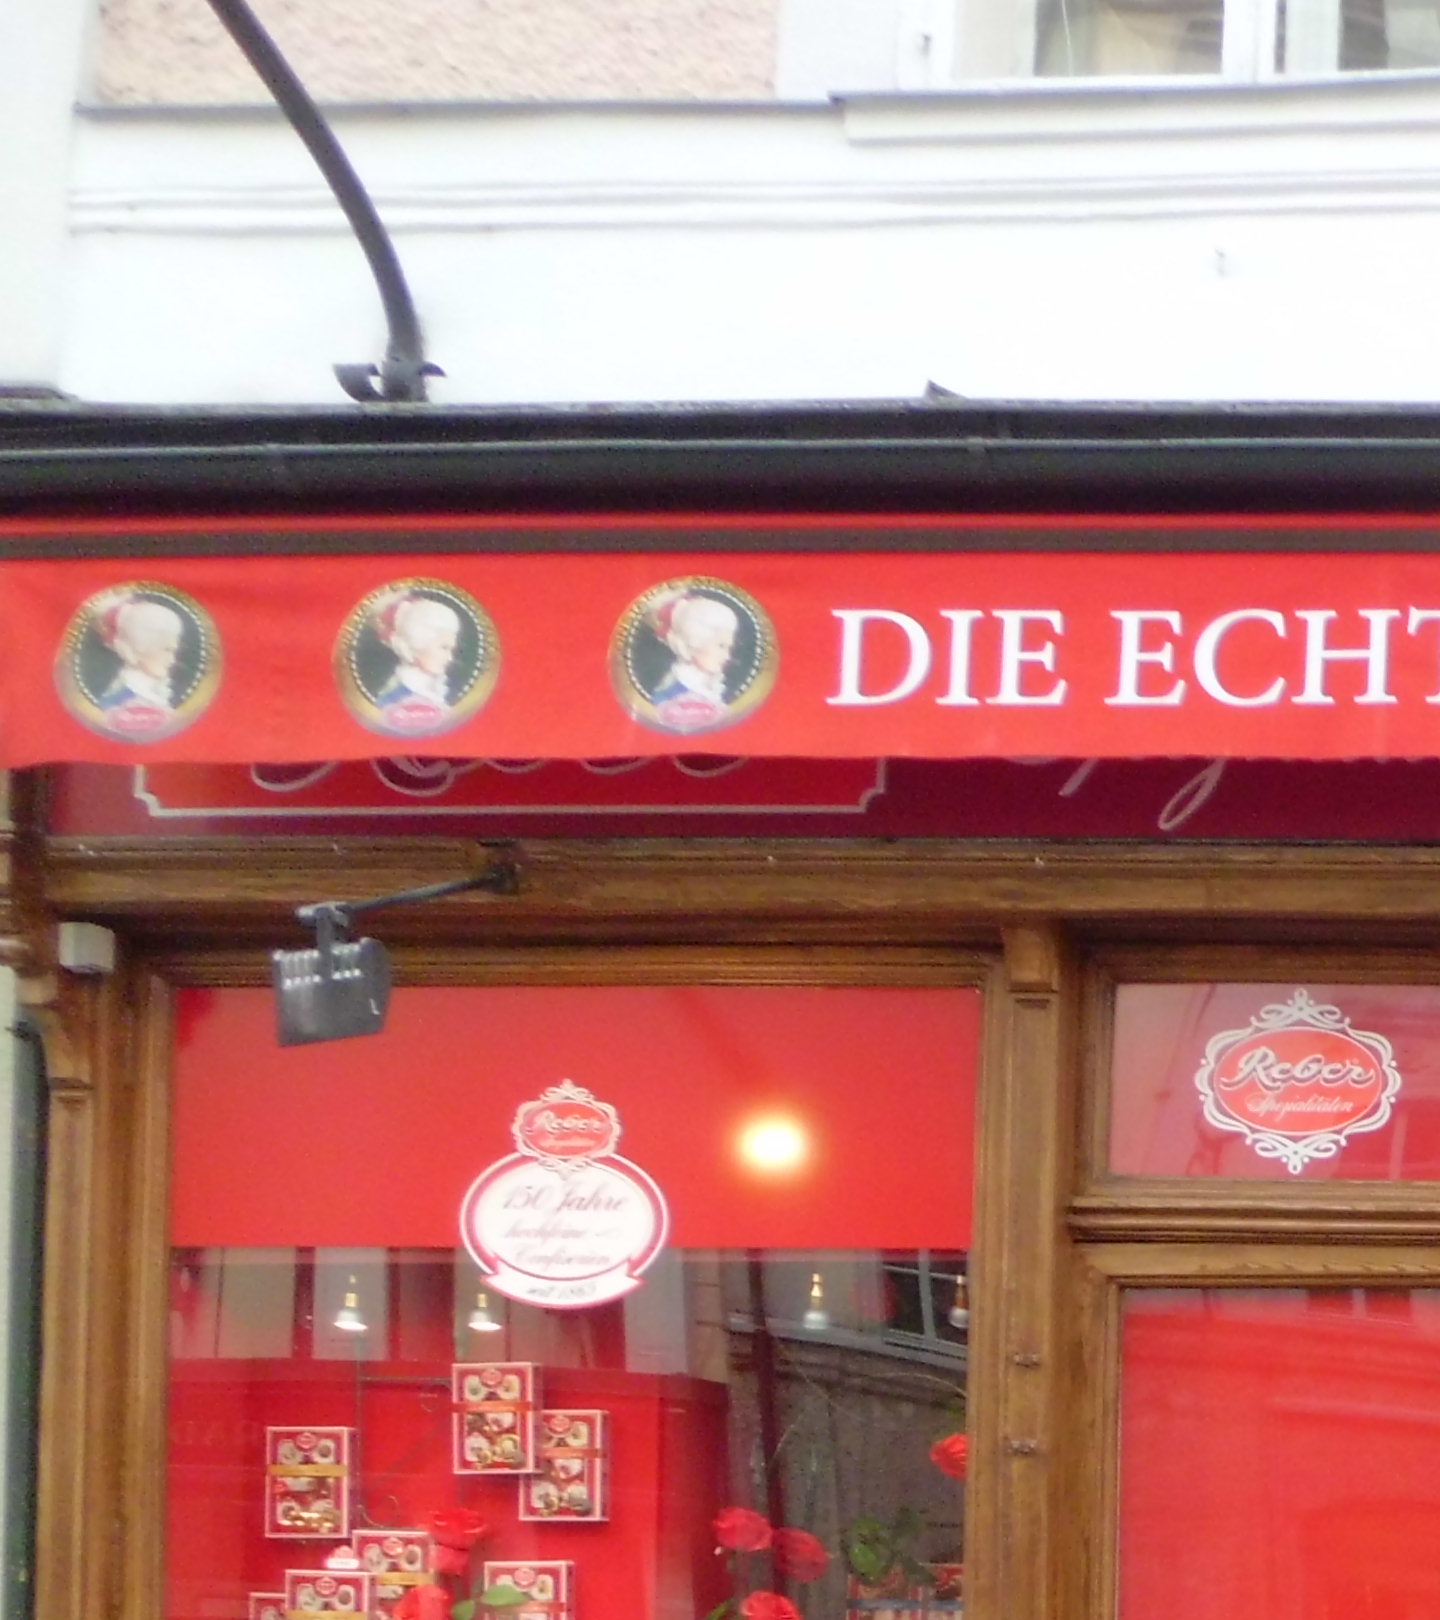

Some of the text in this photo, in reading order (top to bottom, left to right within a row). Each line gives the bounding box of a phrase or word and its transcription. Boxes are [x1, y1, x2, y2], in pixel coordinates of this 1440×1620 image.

[825, 608, 1069, 707] DIE
[1219, 1046, 1375, 1094] Reber
[524, 1110, 608, 1134] Reber
